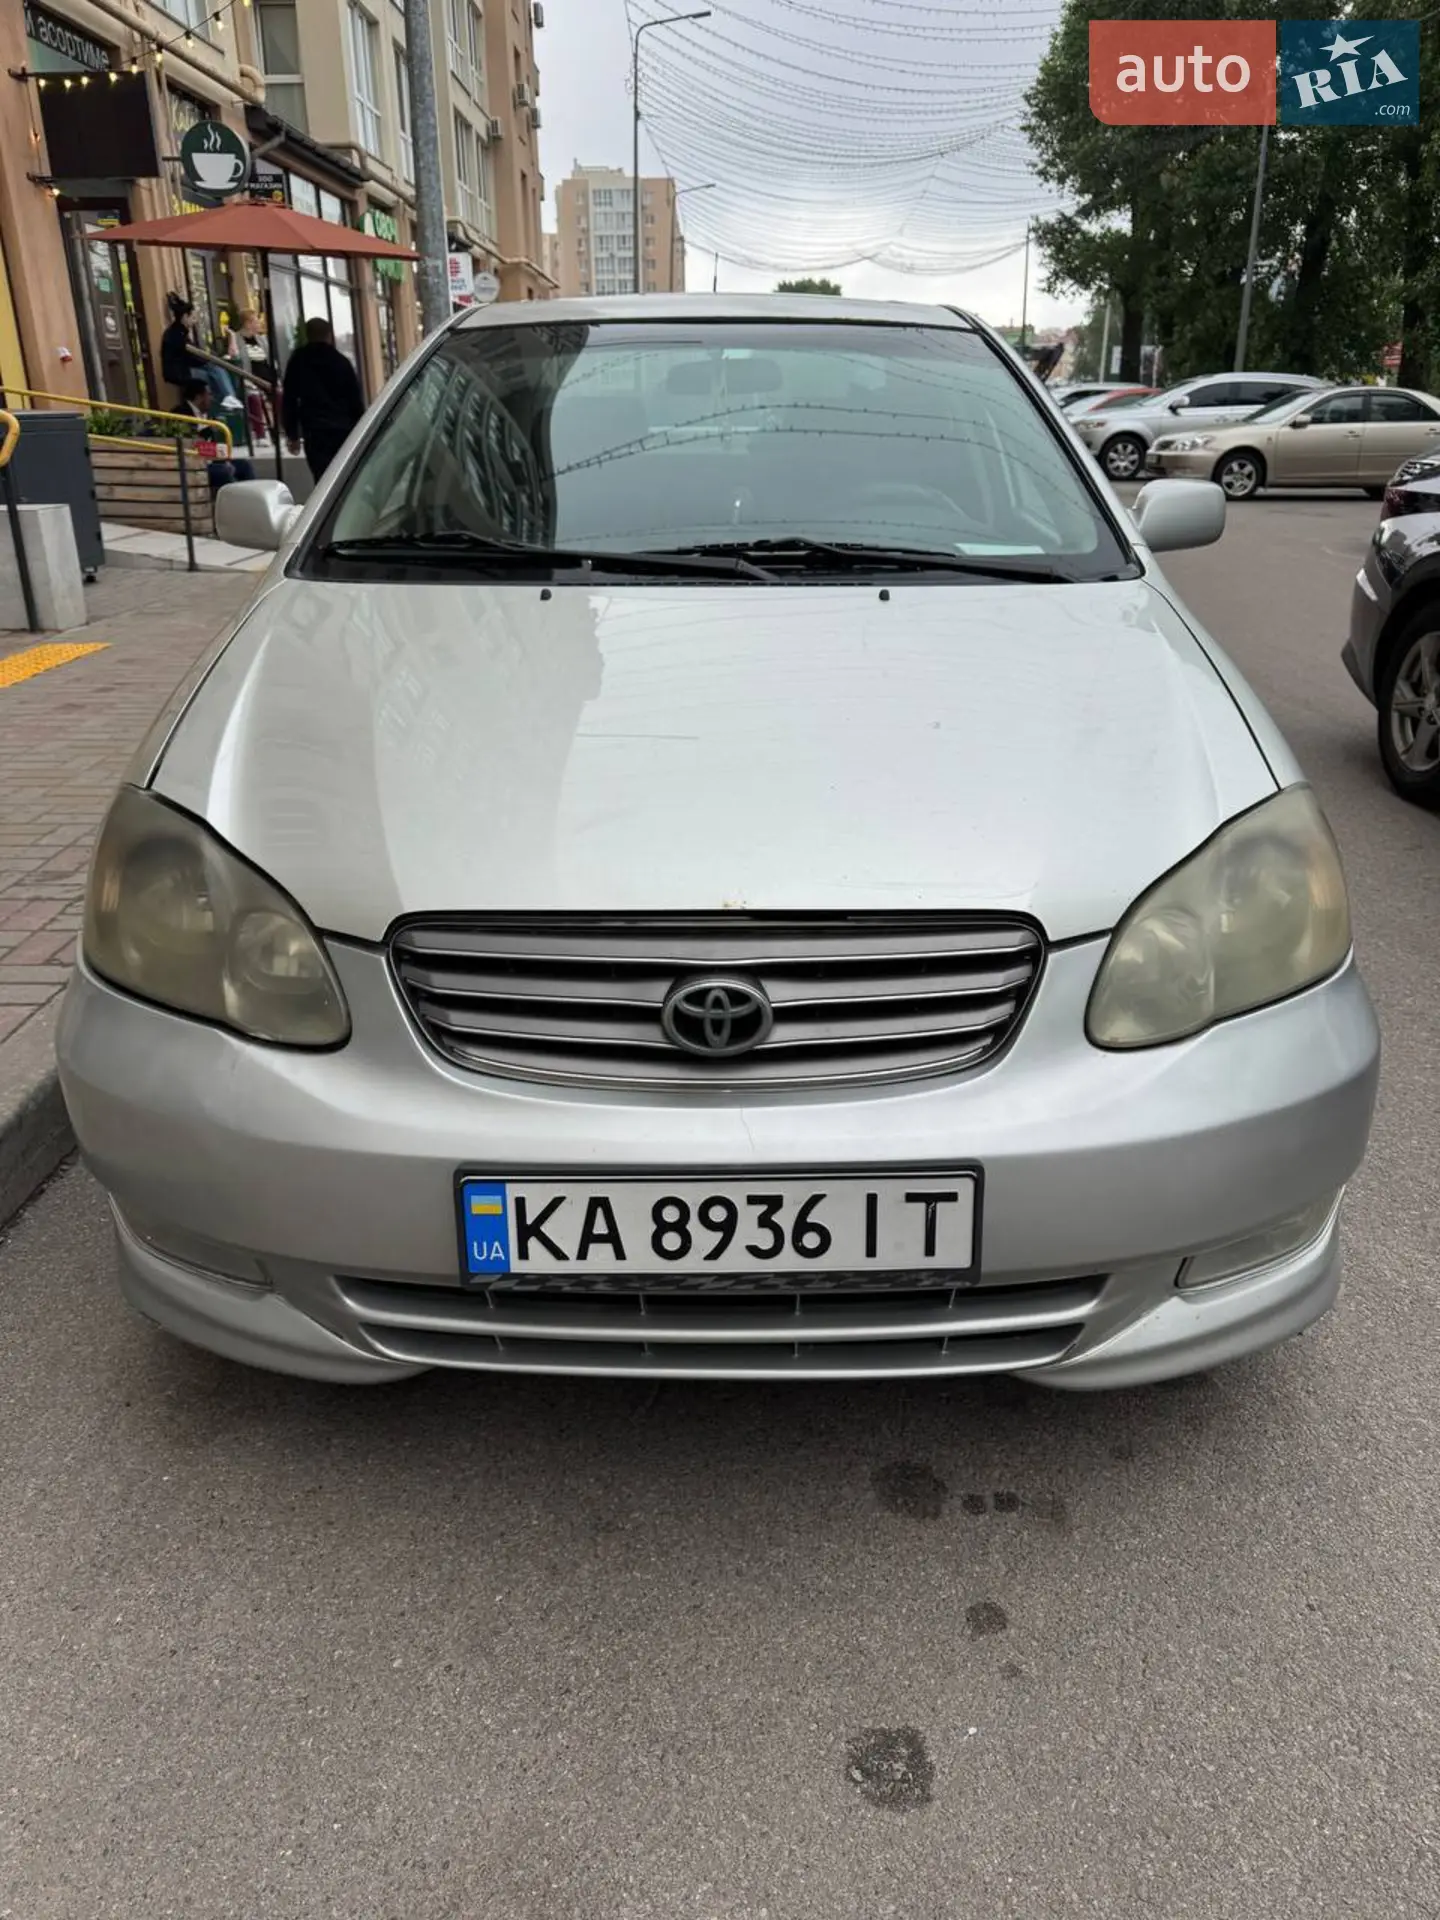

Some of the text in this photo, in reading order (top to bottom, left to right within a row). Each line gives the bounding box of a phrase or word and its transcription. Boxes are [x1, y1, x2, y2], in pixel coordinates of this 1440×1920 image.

[515, 1192, 959, 1262] KA 8936 IT
[473, 1241, 506, 1261] UA
